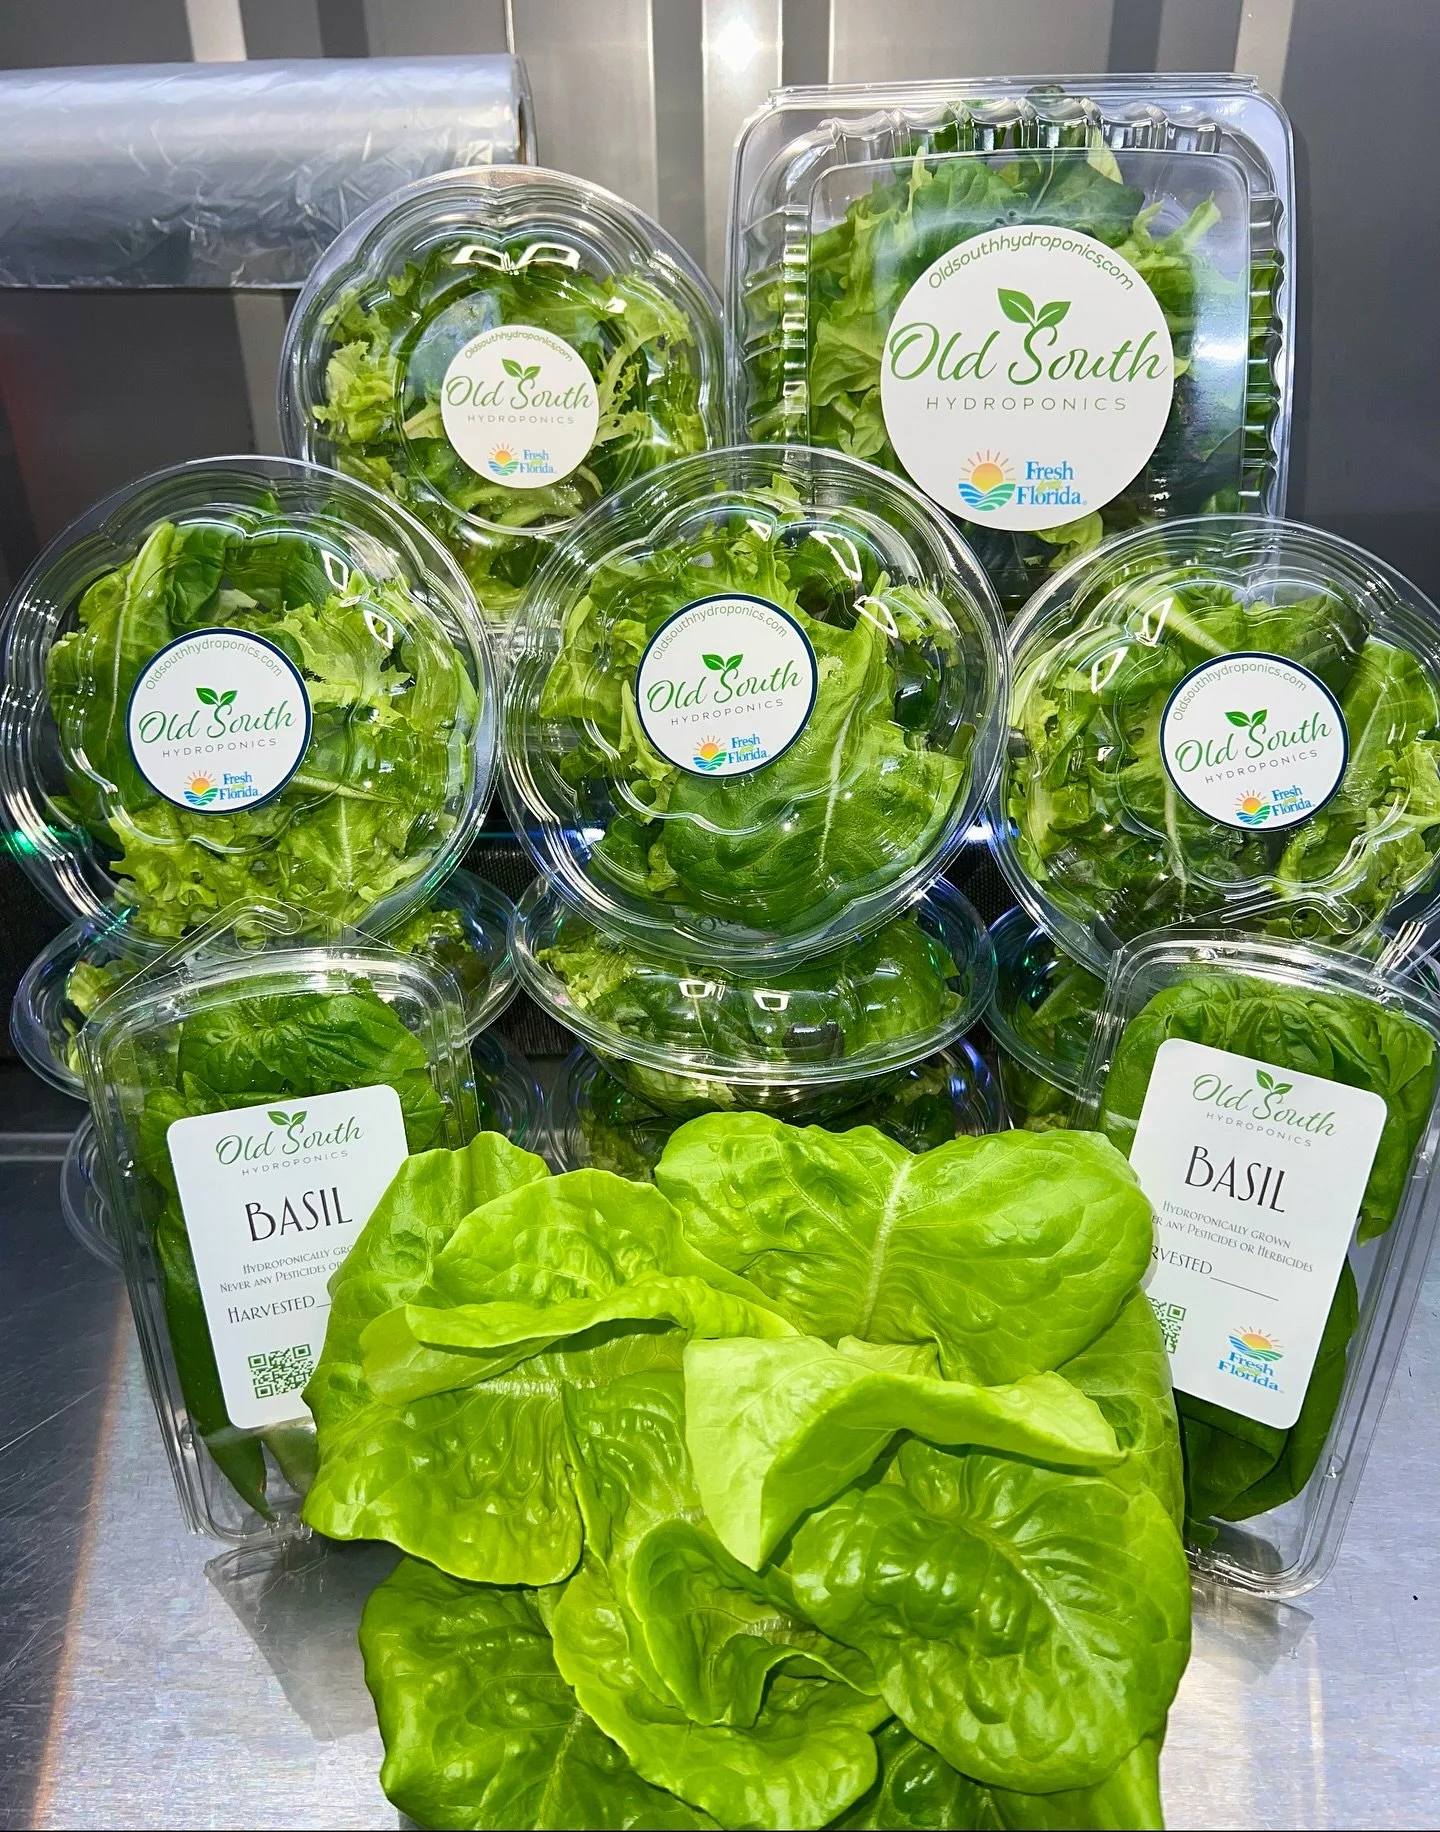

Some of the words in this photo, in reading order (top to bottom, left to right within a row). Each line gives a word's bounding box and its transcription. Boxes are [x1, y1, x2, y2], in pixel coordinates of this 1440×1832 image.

[928, 231, 1134, 291] Oldsouthhydroponics.com
[464, 331, 573, 362] Oldsouthhydroponics.com
[889, 322, 1001, 381] Old
[1008, 324, 1168, 386] South
[446, 375, 505, 407] Old
[511, 378, 593, 410] South
[926, 397, 1127, 411] HYDROPONICS
[467, 415, 575, 425] HYDROPONICS
[523, 449, 549, 460] Fresh
[1025, 460, 1075, 481] Fresh
[1016, 485, 1082, 505] Florida
[652, 605, 788, 661] Oldsouthhydroponics.com
[145, 638, 282, 690] Oldsouthhydroponics.com
[646, 676, 708, 713] Old
[713, 660, 803, 704] South
[1172, 662, 1307, 722] Oldsouthhydroponics.com
[138, 710, 201, 744] Old
[206, 700, 297, 739] South
[670, 698, 784, 726] HYDROPONICS
[162, 738, 277, 758] HYDROPONICS
[728, 749, 768, 764] Florida
[731, 733, 761, 749] Fresh
[1174, 732, 1239, 773] Old
[1244, 711, 1332, 759] South
[223, 771, 253, 785] Fresh
[1204, 749, 1319, 785] HYDROPONICS
[219, 786, 260, 801] Florida
[1271, 784, 1303, 802] Fresh
[1271, 798, 1313, 817] Florida
[1192, 1073, 1254, 1110] Old
[1252, 1090, 1337, 1137] South
[215, 1130, 276, 1165] Old
[281, 1115, 364, 1155] South
[1206, 1111, 1312, 1147] HYDROPONICS
[242, 1149, 349, 1176] HYDROPONICS
[1184, 1145, 1286, 1213] BASIL
[244, 1186, 353, 1242] BASIL
[1162, 1200, 1249, 1236] HYDROPONICALLY
[1250, 1229, 1291, 1249] GROWN
[243, 1249, 330, 1275] HYDROPONICALLY
[332, 1244, 353, 1256] GRO
[1151, 1245, 1213, 1275] RVESTED
[1166, 1219, 1185, 1232] ANY
[1187, 1223, 1238, 1249] PESTICIDES
[1239, 1241, 1255, 1254] OR
[1257, 1245, 1314, 1273] HERBICIDES
[219, 1280, 251, 1293] NEVER
[254, 1275, 273, 1288] ANY
[275, 1264, 326, 1283] PESTICIDES
[227, 1294, 316, 1324] HARVESTED
[1217, 1360, 1279, 1391] Florida
[1228, 1351, 1274, 1377] Fresh
